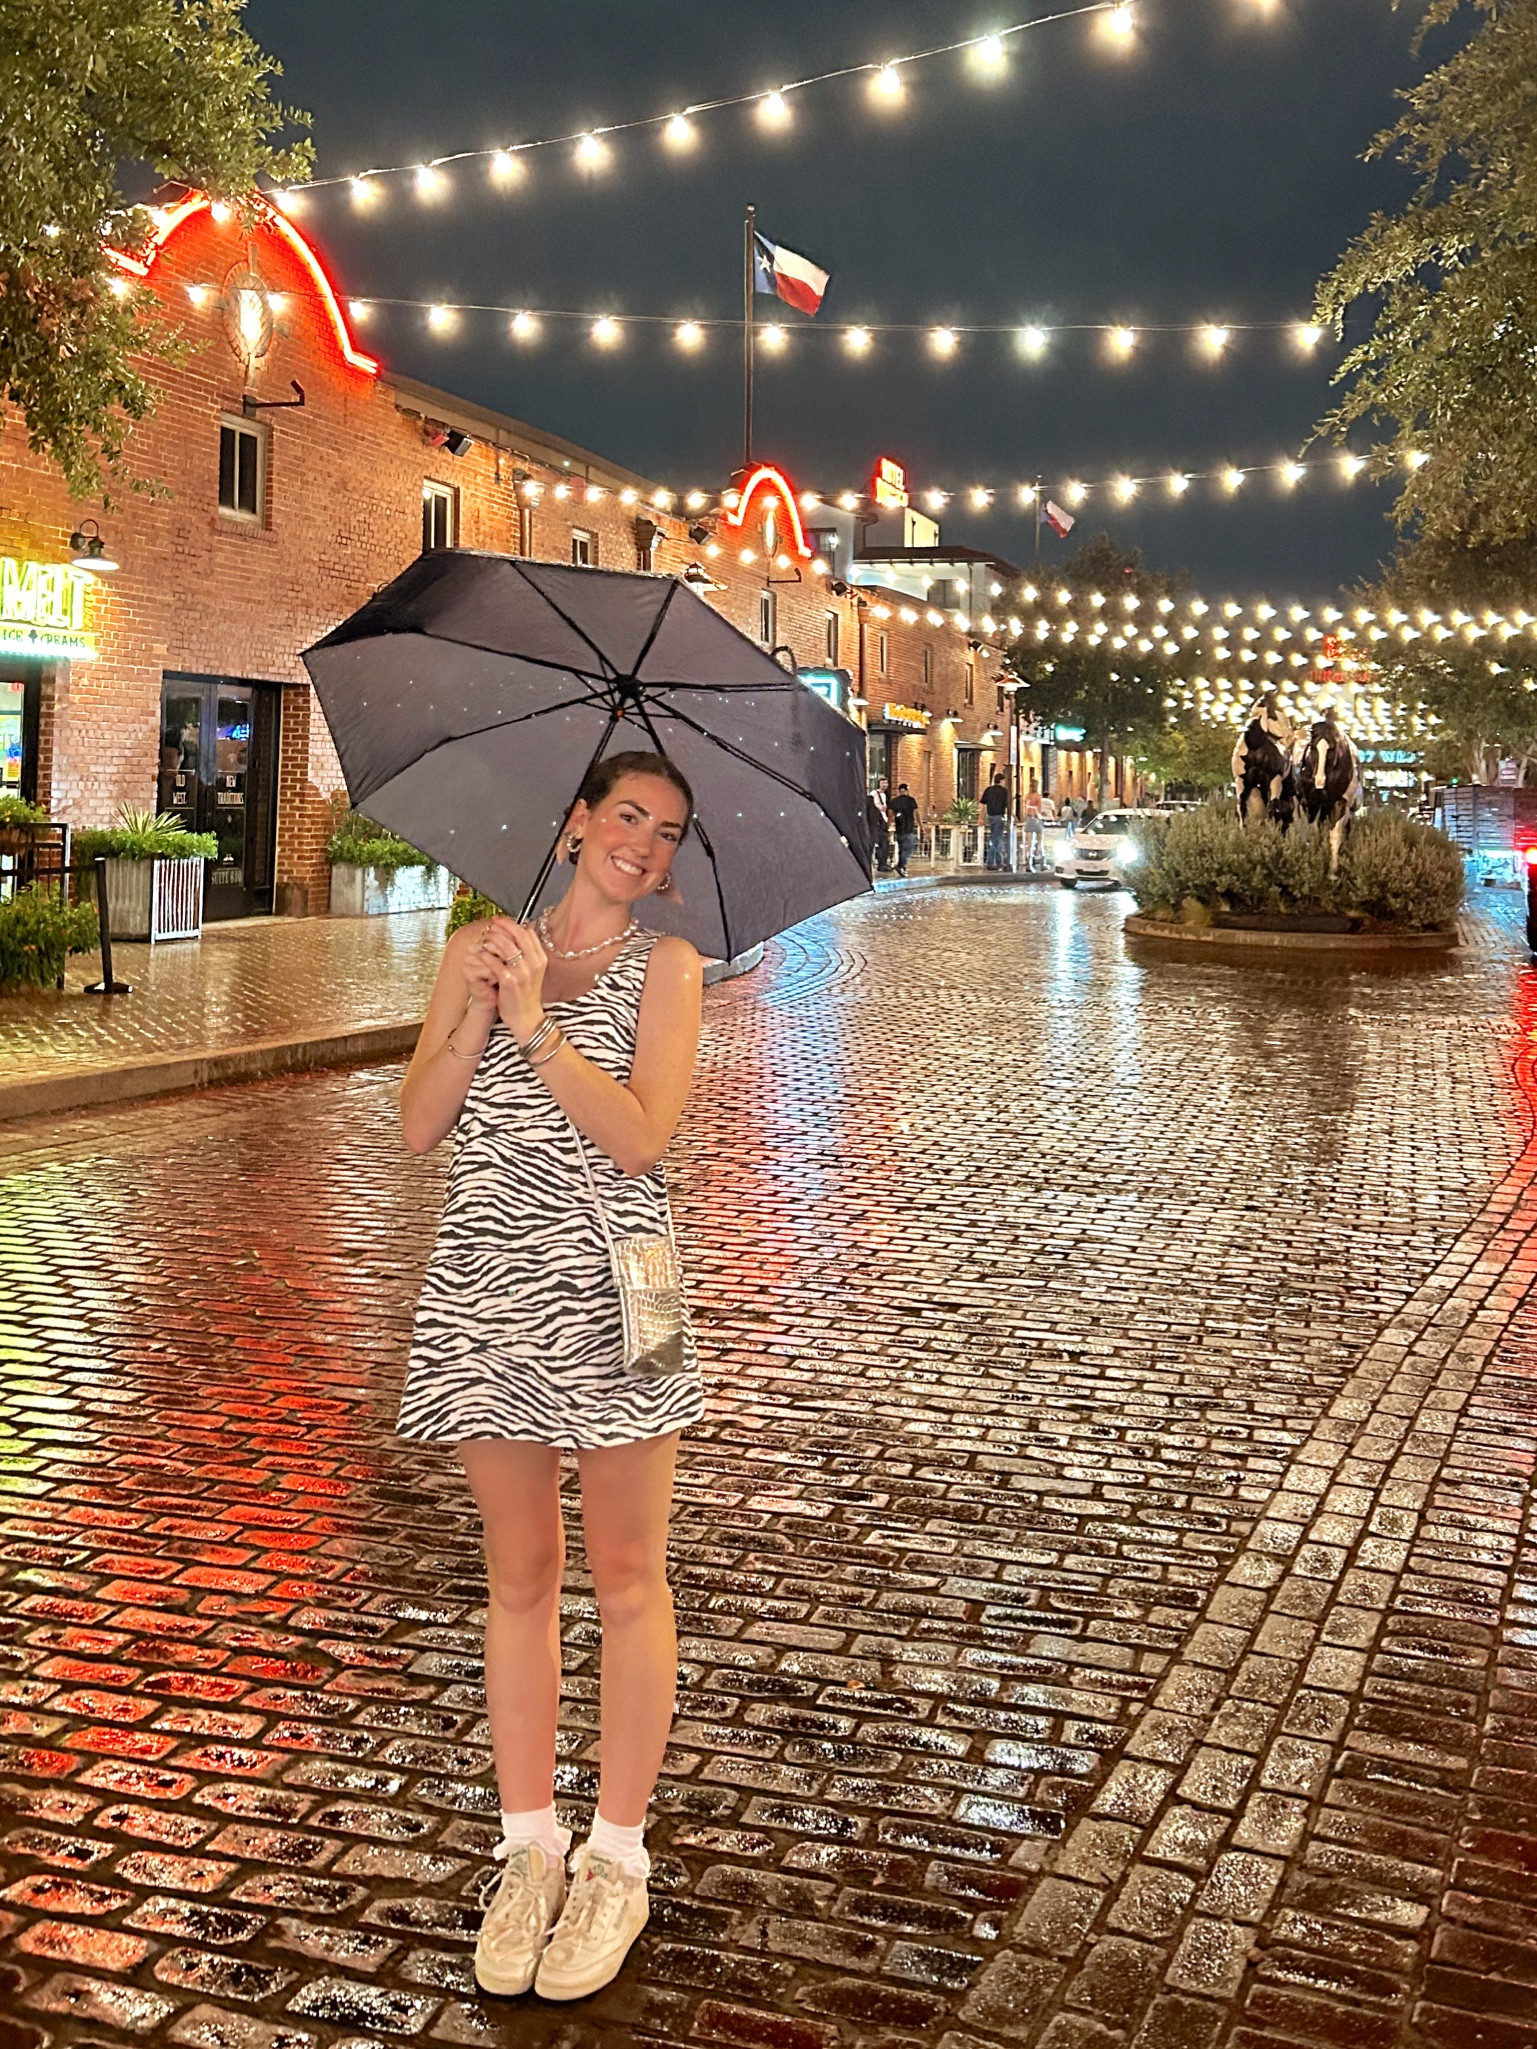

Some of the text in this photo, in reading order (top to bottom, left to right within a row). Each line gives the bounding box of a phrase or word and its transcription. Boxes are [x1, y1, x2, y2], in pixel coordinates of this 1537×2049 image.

[1, 558, 93, 629] MELT
[3, 629, 86, 648] ICE CREAMS
[225, 775, 237, 788] NEW
